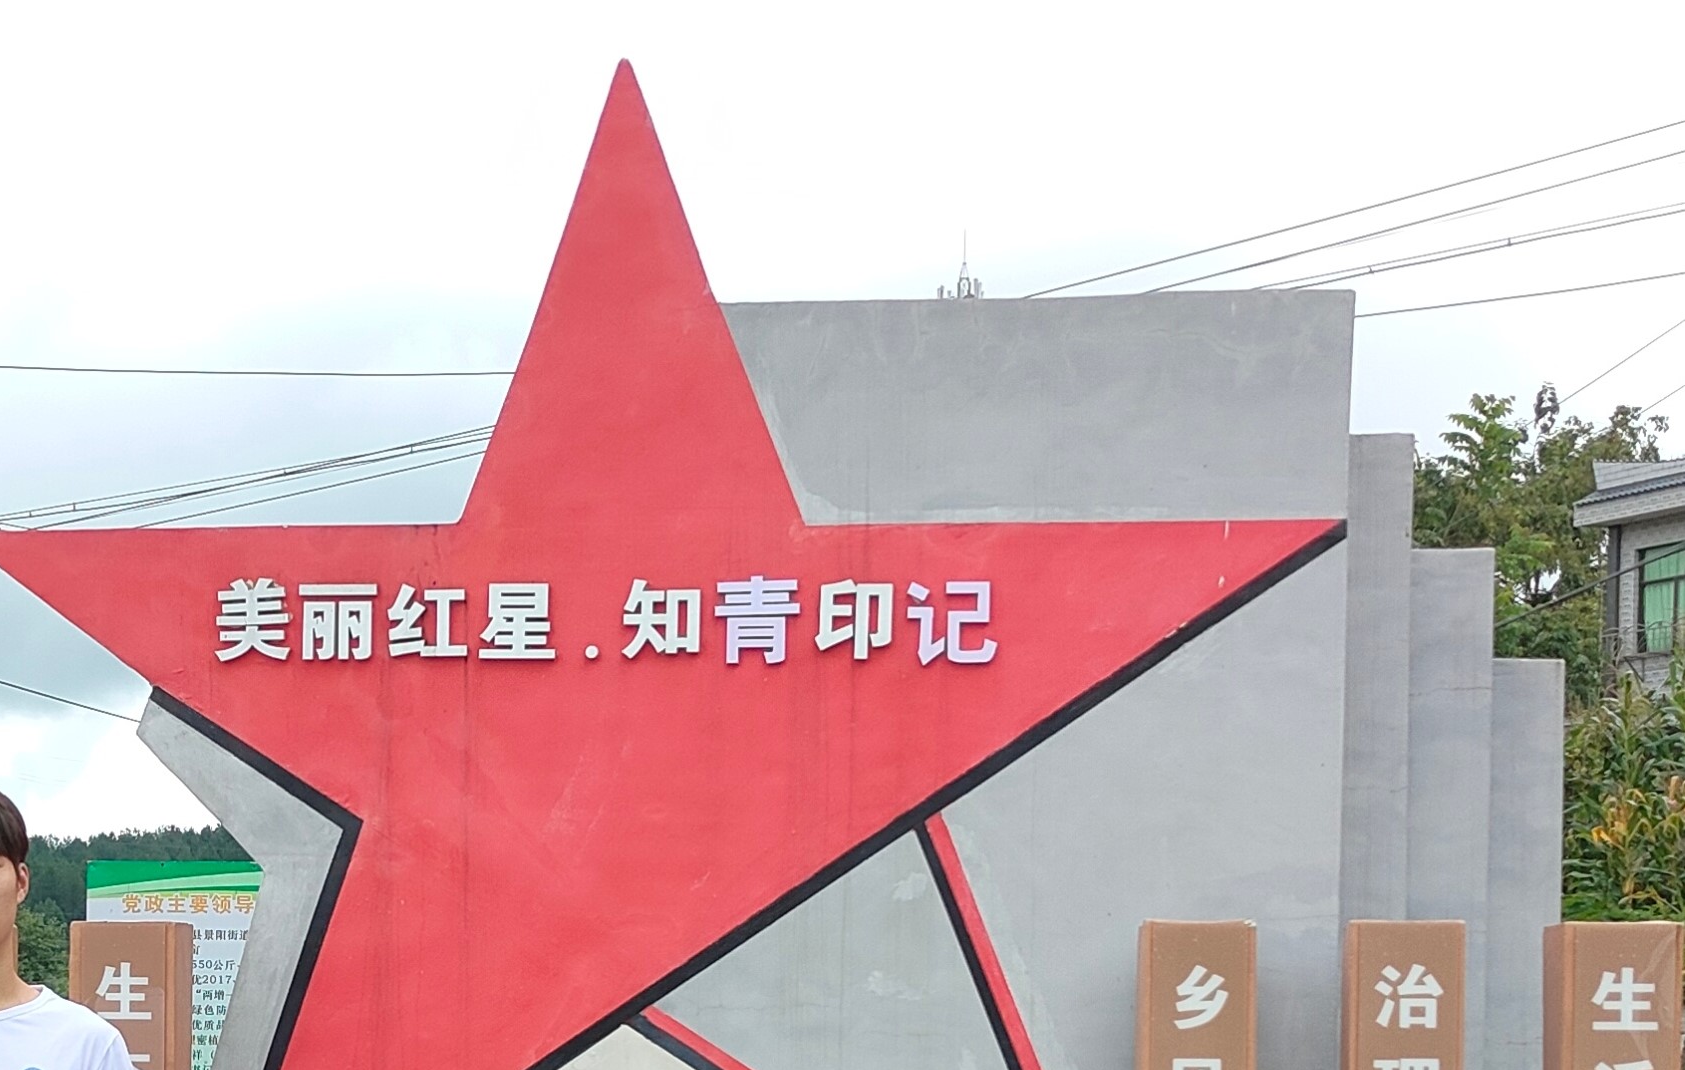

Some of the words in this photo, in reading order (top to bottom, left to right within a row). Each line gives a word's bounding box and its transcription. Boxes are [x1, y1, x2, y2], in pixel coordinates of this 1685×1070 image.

[122, 894, 254, 914] 党政主要领导
